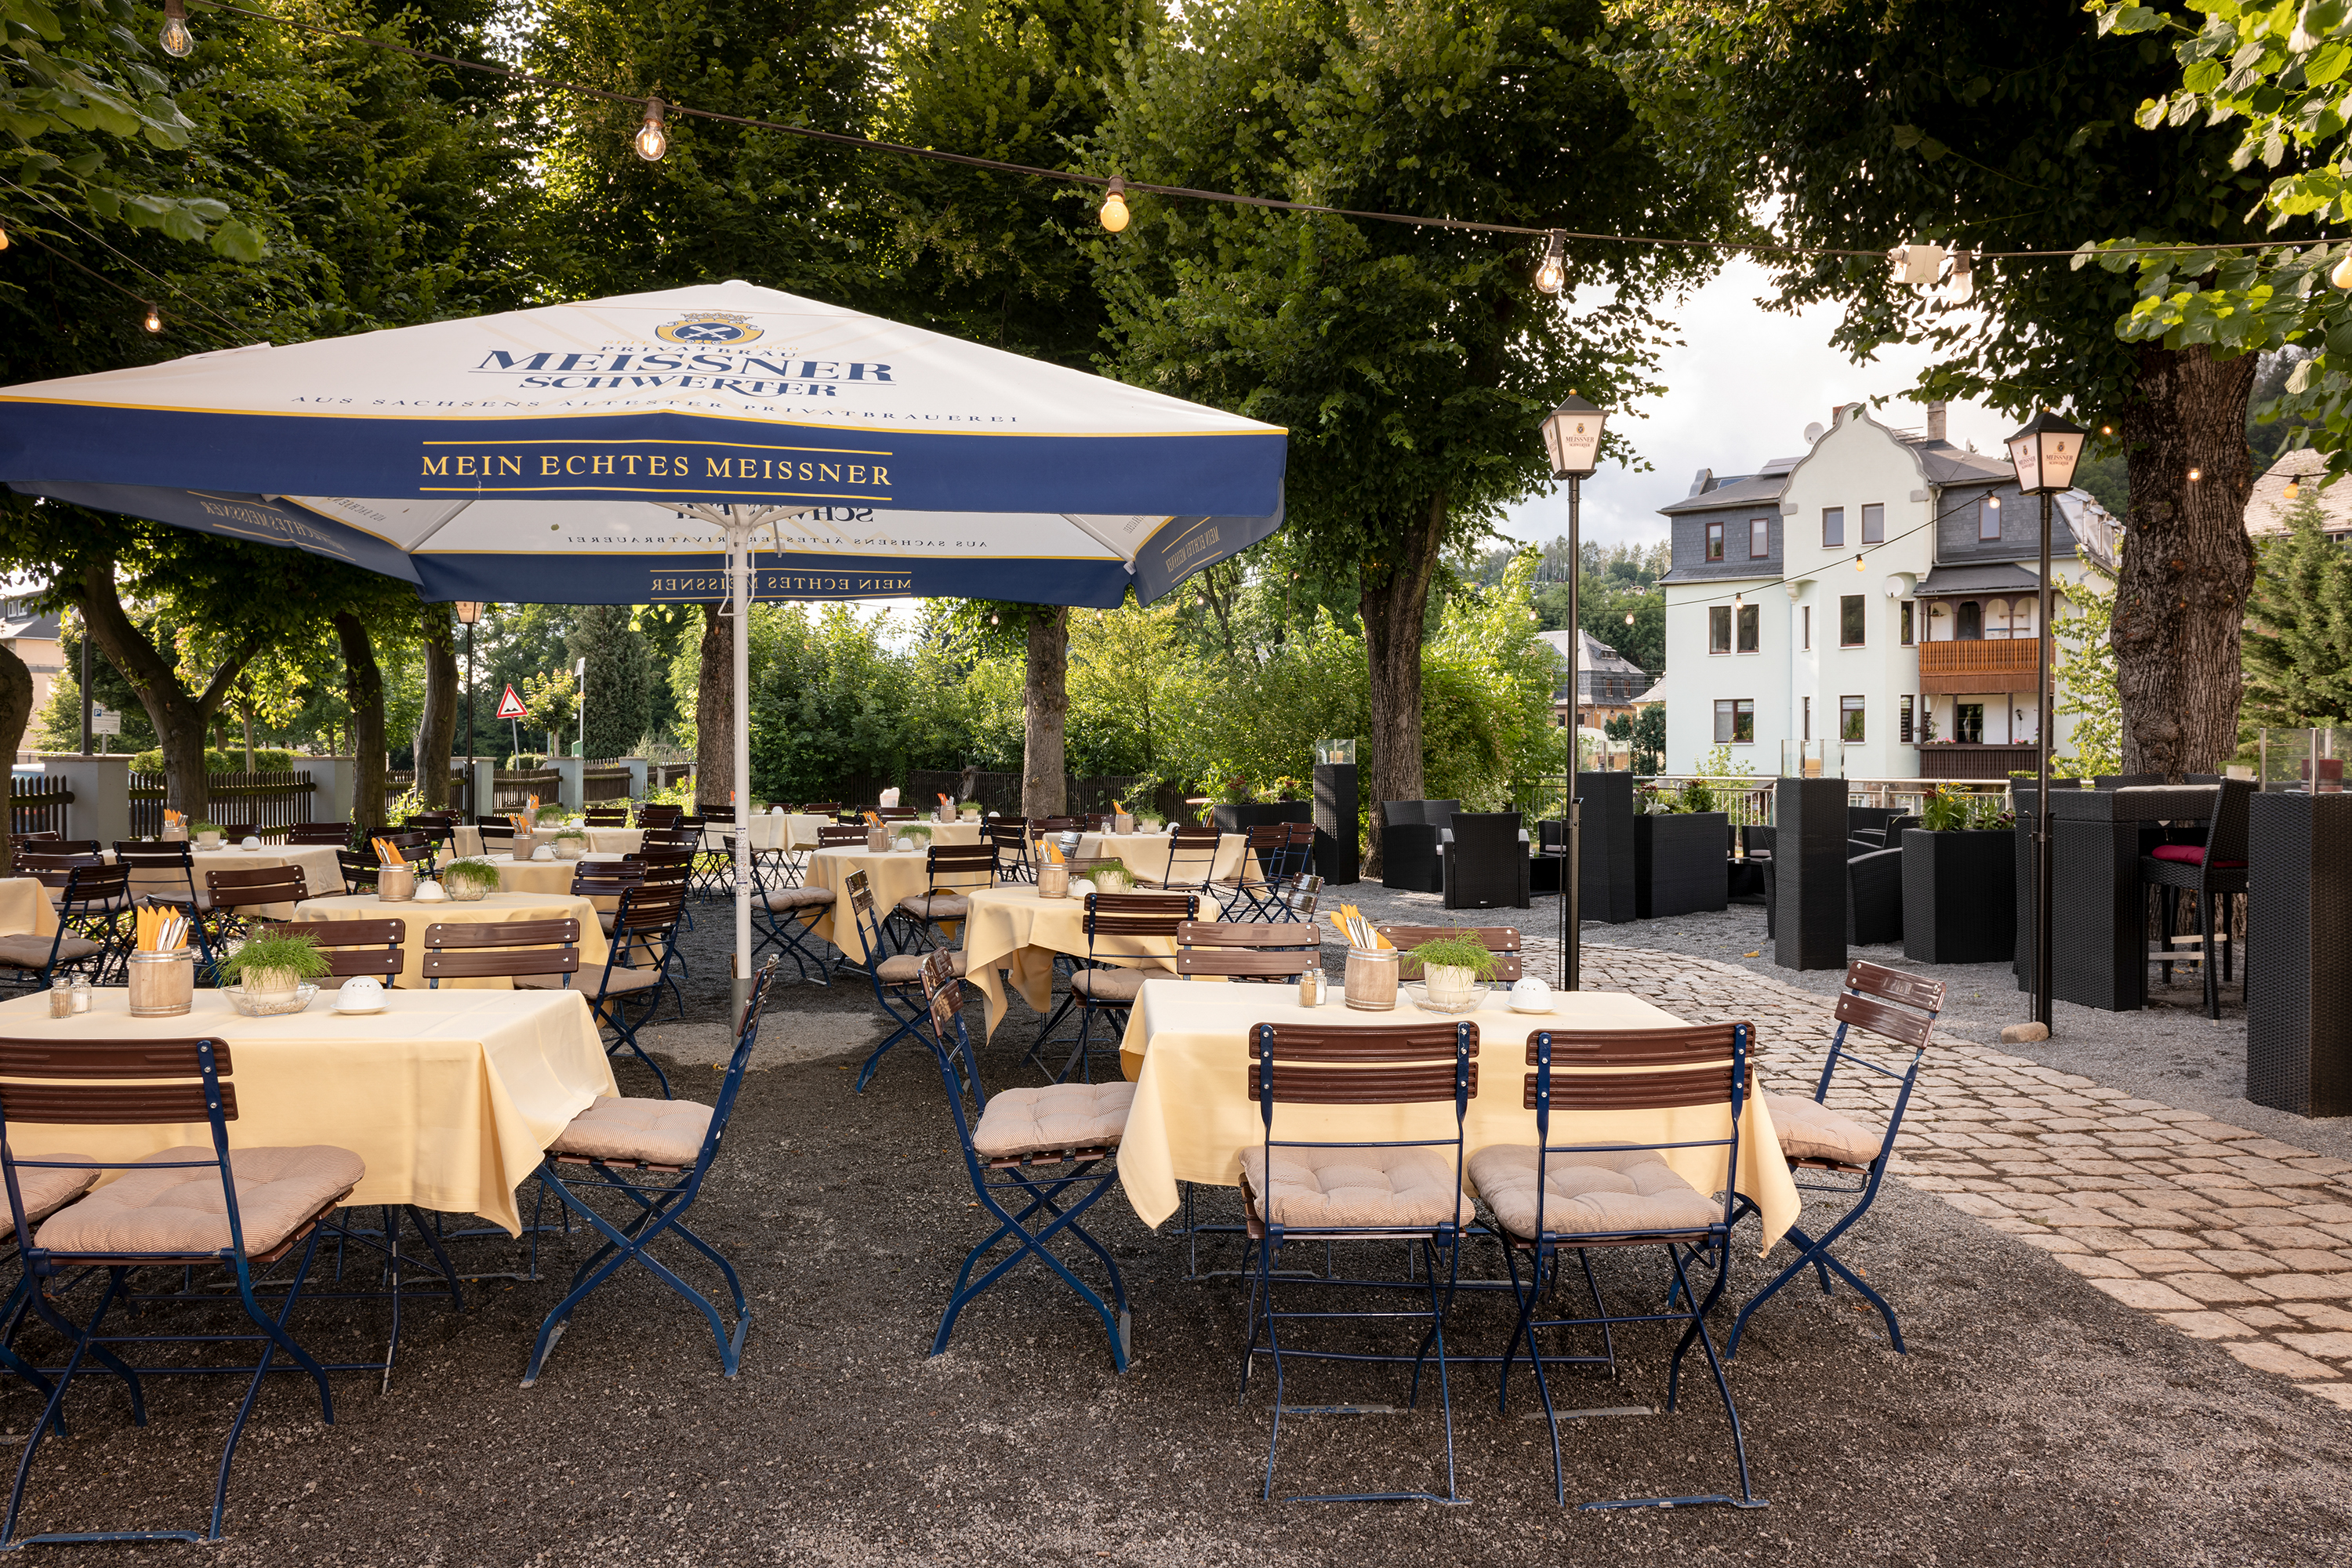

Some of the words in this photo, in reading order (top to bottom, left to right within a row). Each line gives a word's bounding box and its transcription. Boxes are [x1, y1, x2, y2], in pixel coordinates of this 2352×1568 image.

[599, 346, 797, 358] PRIVATBRÄU
[472, 350, 894, 382] MEISSNER
[518, 376, 837, 397] SCHWERTER
[372, 398, 539, 408] SACHSENS
[559, 399, 723, 408] ÄLTESTER
[744, 405, 1018, 423] PRIVATBRAUEREI
[421, 456, 523, 476] MEIN
[539, 456, 689, 476] ECHTES
[706, 457, 892, 486] MEISSNER
